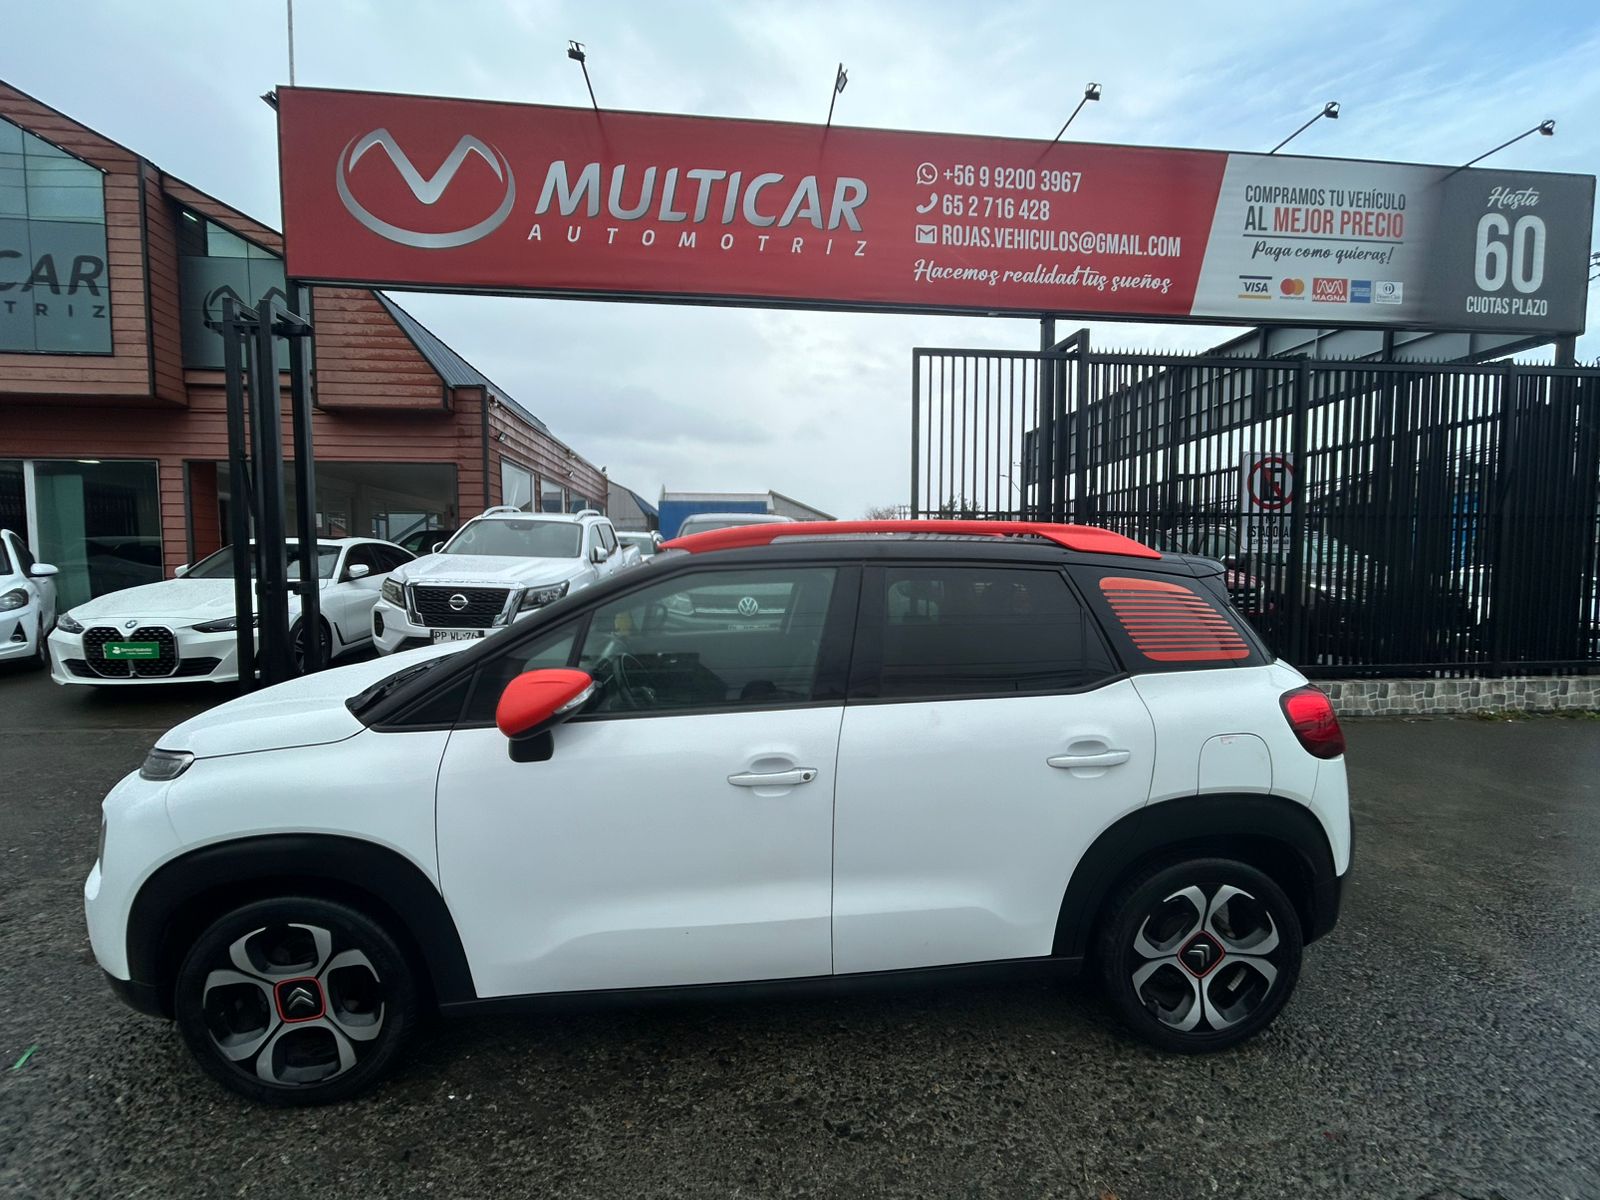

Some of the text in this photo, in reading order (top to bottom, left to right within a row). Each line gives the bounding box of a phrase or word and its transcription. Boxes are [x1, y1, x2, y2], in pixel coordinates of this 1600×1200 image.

[943, 165, 1082, 193] +56 9 9200 3967
[535, 160, 868, 231] MULTICAR
[942, 194, 1050, 221] 65 2 716 428
[1245, 185, 1406, 211] COMPRAMOS TU VEHÍCULO
[1487, 186, 1541, 210] Hasta
[1244, 205, 1404, 238] AL MEJOR PRECIO
[528, 224, 866, 256] AUTOMOTRIZ
[942, 224, 1181, 257] ROJAS.VEHICULOS@GMAIL.COM
[1252, 240, 1394, 265] Paga como quieras!
[1474, 212, 1546, 294] 60
[913, 258, 1173, 294] Hacemos realidad tus sueños
[1243, 282, 1269, 293] VISA
[1312, 294, 1347, 302] MAGNA
[1466, 295, 1547, 316] CUOTAS PLAZO
